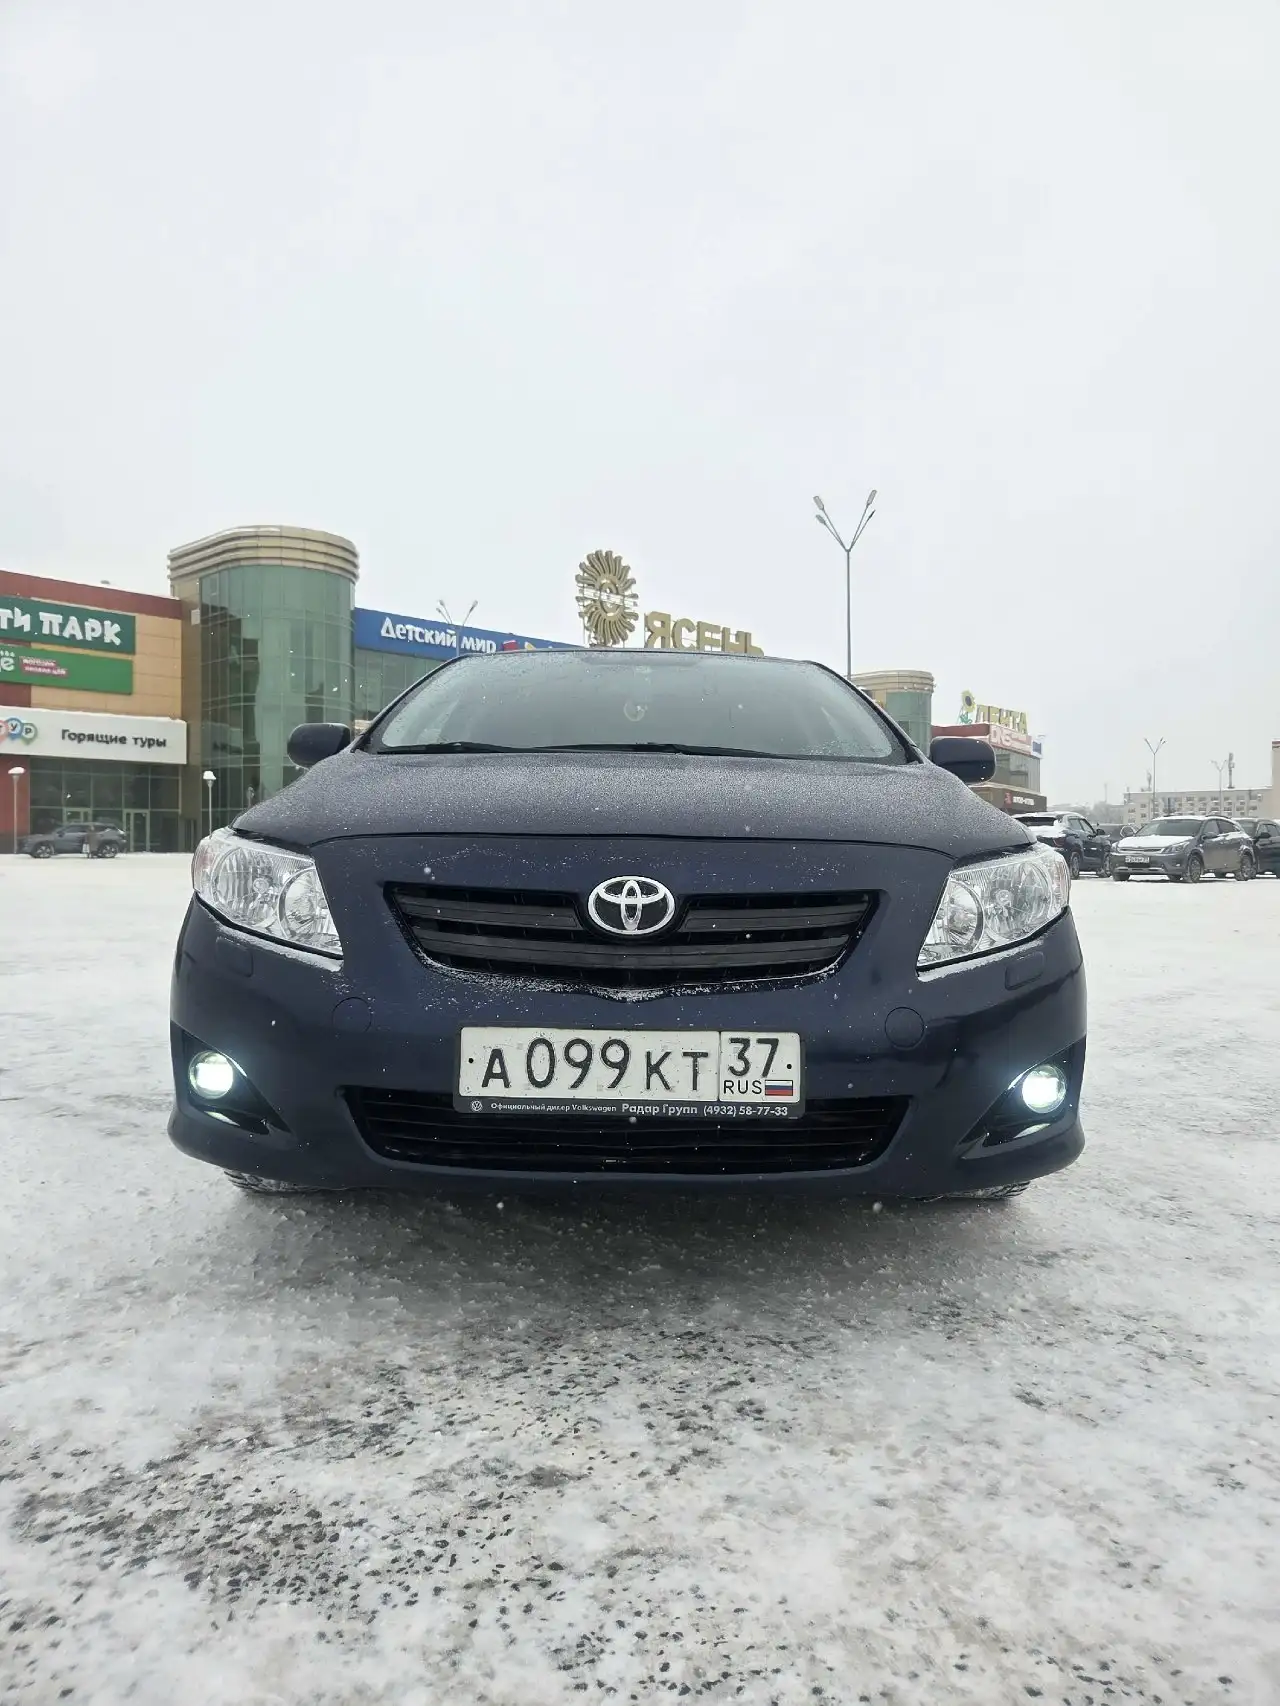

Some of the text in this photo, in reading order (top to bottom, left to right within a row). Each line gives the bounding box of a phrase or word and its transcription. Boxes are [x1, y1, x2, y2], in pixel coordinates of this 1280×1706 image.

[40, 611, 121, 646] ПАРК
[381, 617, 457, 649] Детский
[645, 611, 764, 656] ЯСЕНЬ
[975, 704, 1028, 735] ЛЕНТА
[61, 729, 167, 749] Горящие туры
[728, 1037, 780, 1078] 37
[723, 1079, 762, 1095] RUS
[491, 1102, 545, 1112] Официальный
[572, 1104, 617, 1114] Volkswagen
[622, 1103, 660, 1115] Радар
[663, 1104, 698, 1116] Групп
[703, 1105, 737, 1118] (4932)
[739, 1106, 788, 1117] 58-77-33
